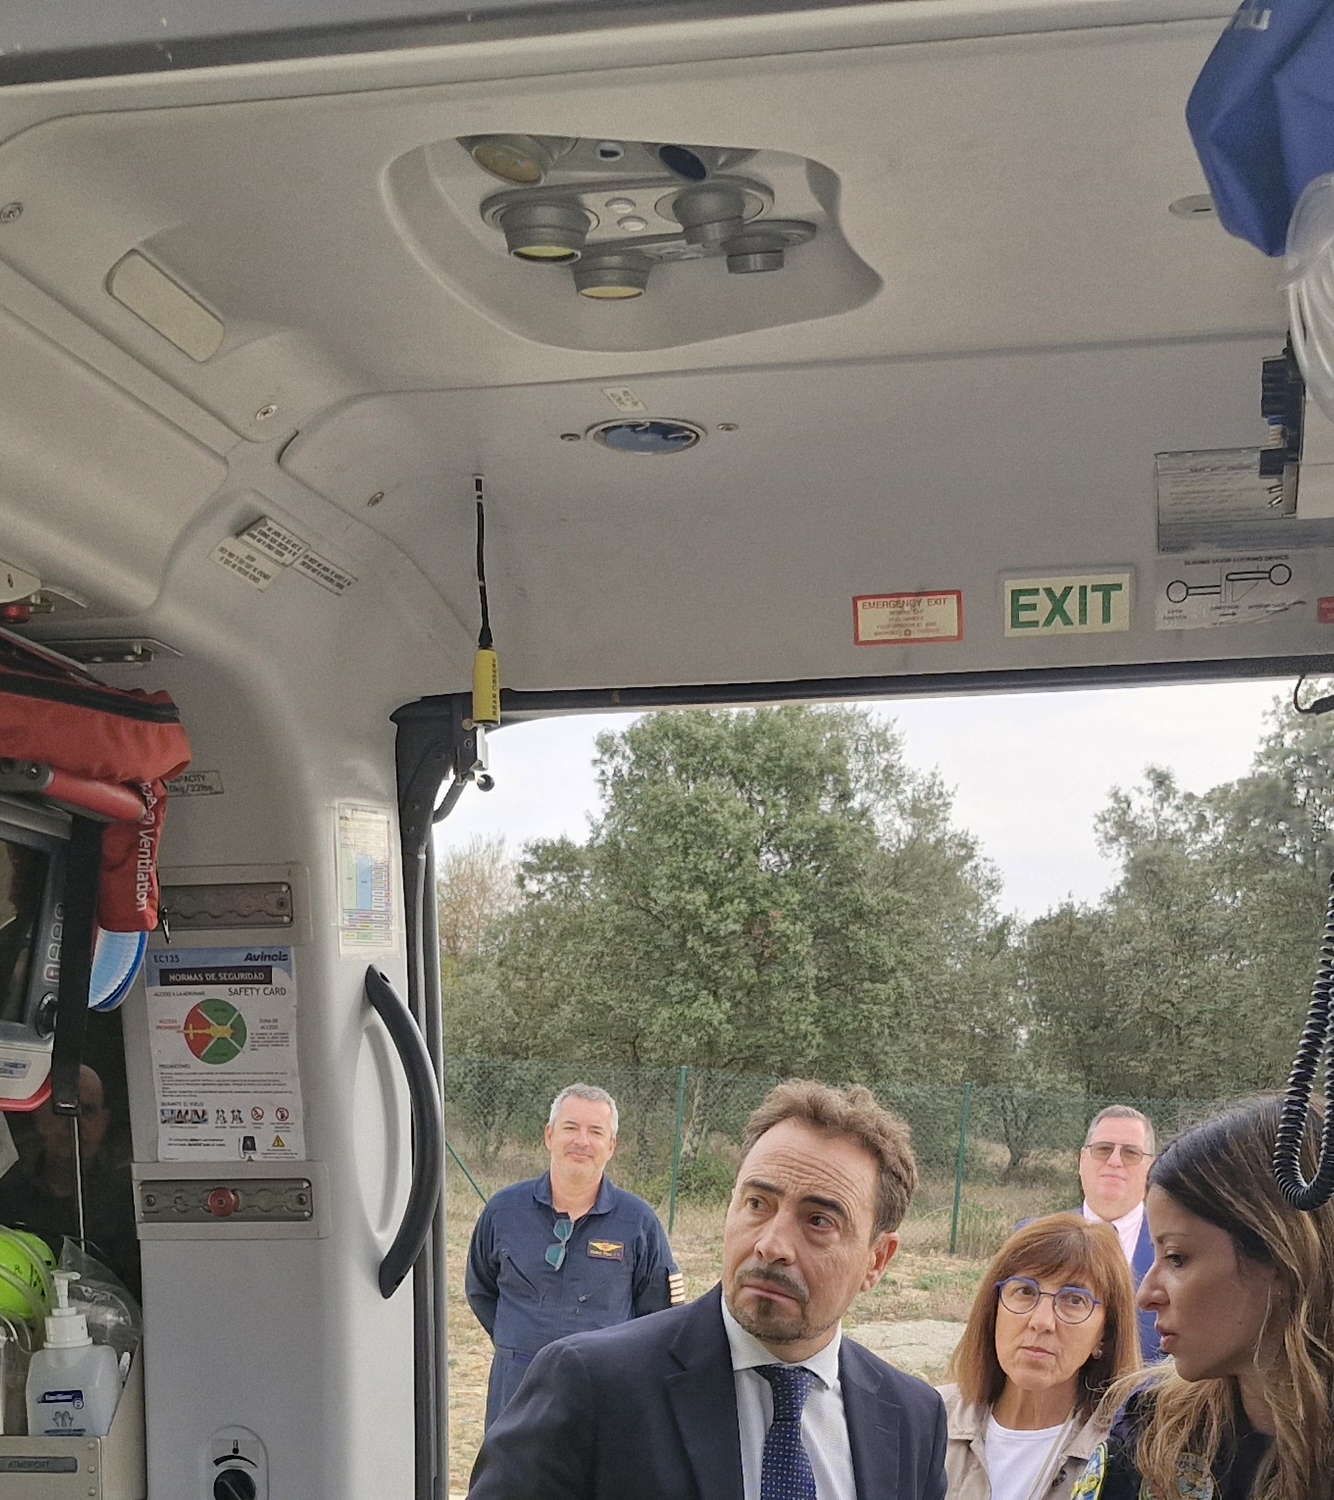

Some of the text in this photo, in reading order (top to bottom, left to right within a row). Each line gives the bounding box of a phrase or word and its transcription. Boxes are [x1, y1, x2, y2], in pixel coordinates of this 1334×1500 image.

[862, 598, 948, 610] EMERGENCY EXIT
[1010, 583, 1123, 629] EXIT
[136, 828, 155, 912] Ventilation
[153, 954, 180, 964] EC135
[169, 972, 265, 982] NORMAS DE SEGURIDAD
[228, 987, 287, 996] SAFETY CARD
